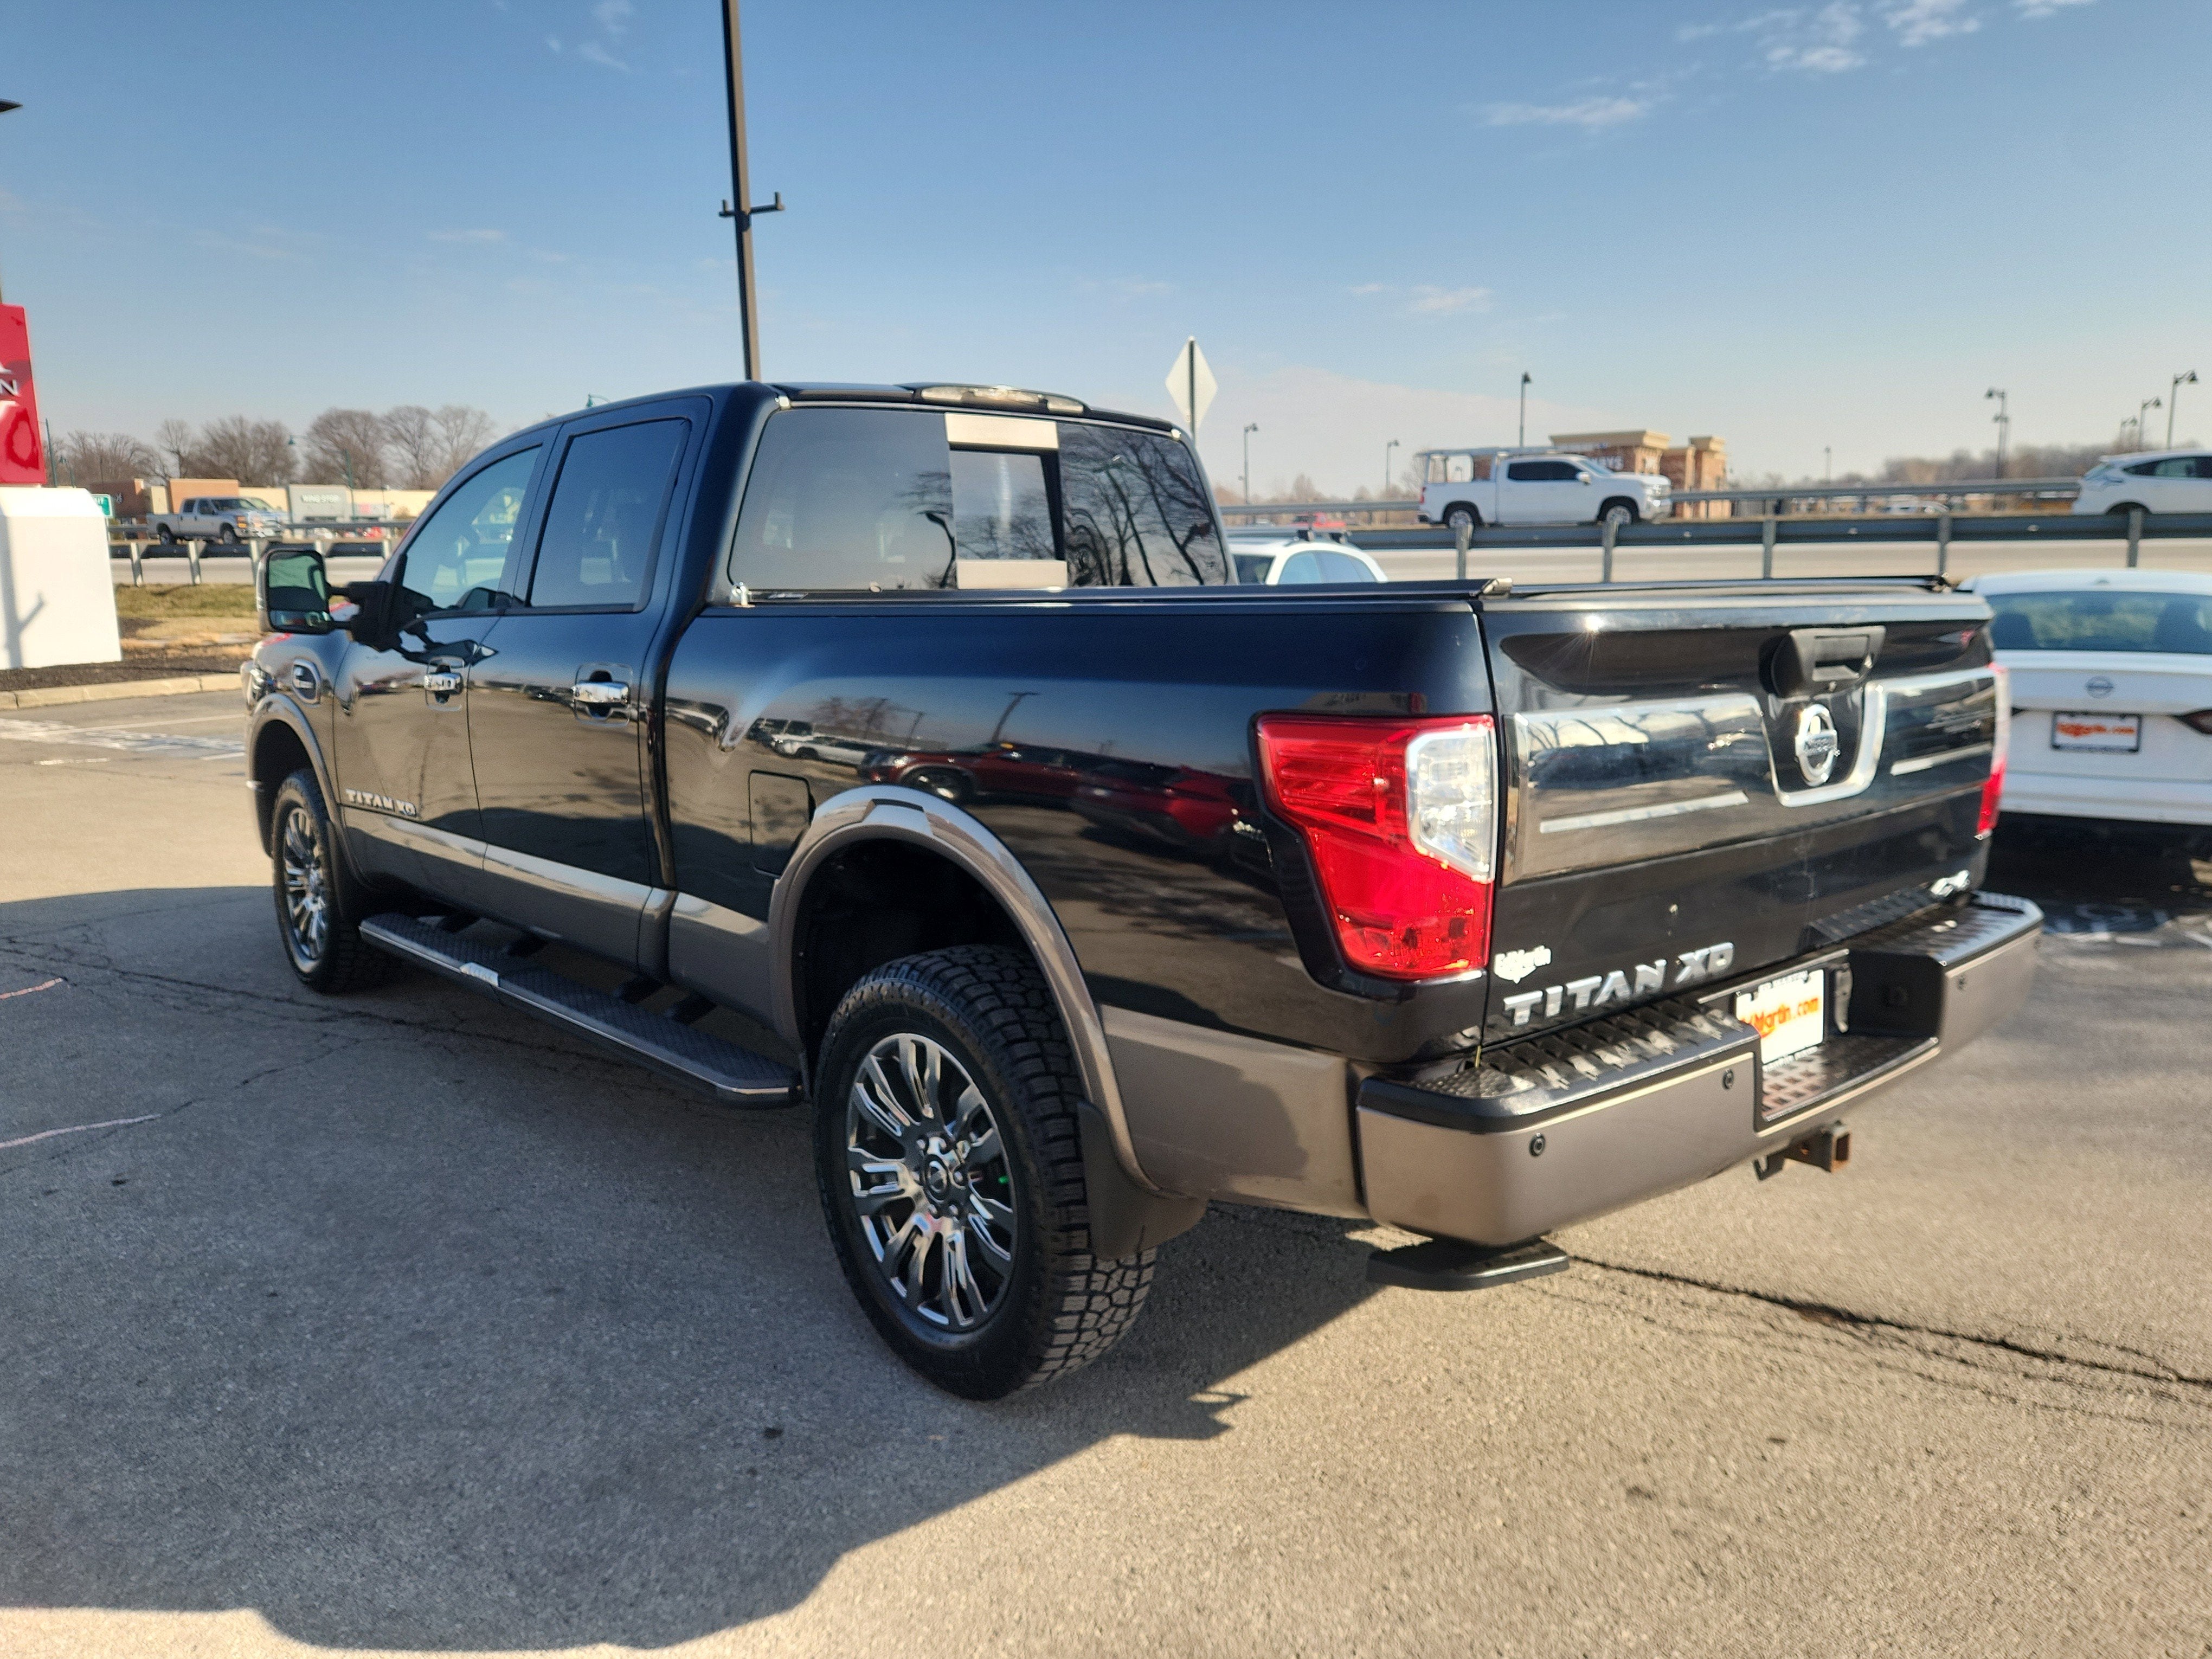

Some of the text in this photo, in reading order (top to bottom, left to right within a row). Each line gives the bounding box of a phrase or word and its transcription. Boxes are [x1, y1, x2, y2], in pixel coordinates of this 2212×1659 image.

[345, 788, 394, 811] TITAN
[1503, 942, 1734, 1026] TITAN XD
